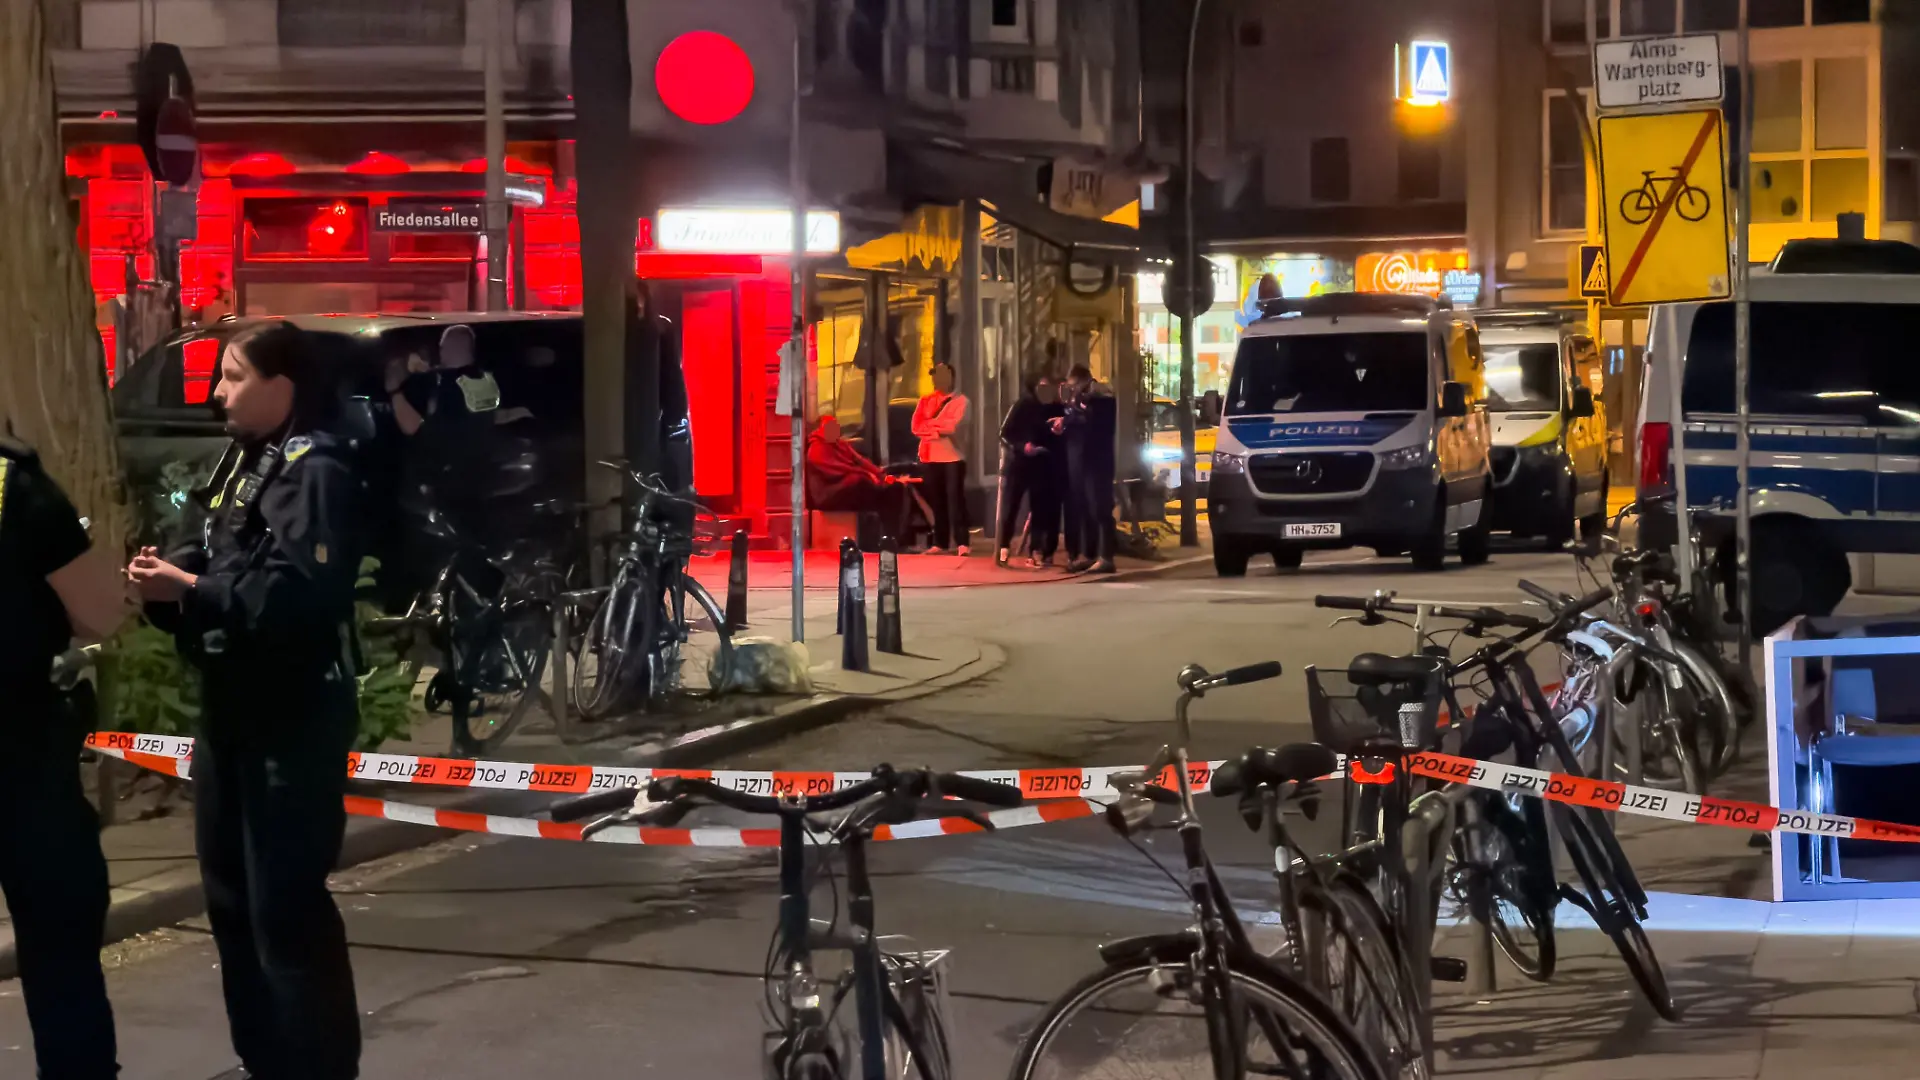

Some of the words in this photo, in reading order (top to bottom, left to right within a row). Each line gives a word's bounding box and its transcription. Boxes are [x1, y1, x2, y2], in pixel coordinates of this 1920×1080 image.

[1605, 61, 1712, 80] Wartenberg-
[1638, 81, 1681, 100] platz
[379, 212, 478, 227] Friedensallee
[1269, 426, 1359, 437] POLIZEI
[1310, 524, 1335, 535] 3752
[107, 735, 163, 752] POLIZEI
[377, 762, 435, 778] POLIZEI
[446, 766, 506, 782] POLIZEI
[518, 770, 576, 786] POLIZEI
[734, 778, 793, 794] POLIZEI
[1030, 775, 1091, 792] POLIZEI
[1410, 756, 1486, 780] POLIZEI
[1501, 772, 1576, 797] POLIZEI
[1591, 788, 1667, 811] POLIZEI
[1683, 801, 1760, 824] POLIZEI
[1776, 813, 1854, 832] POLIZEI
